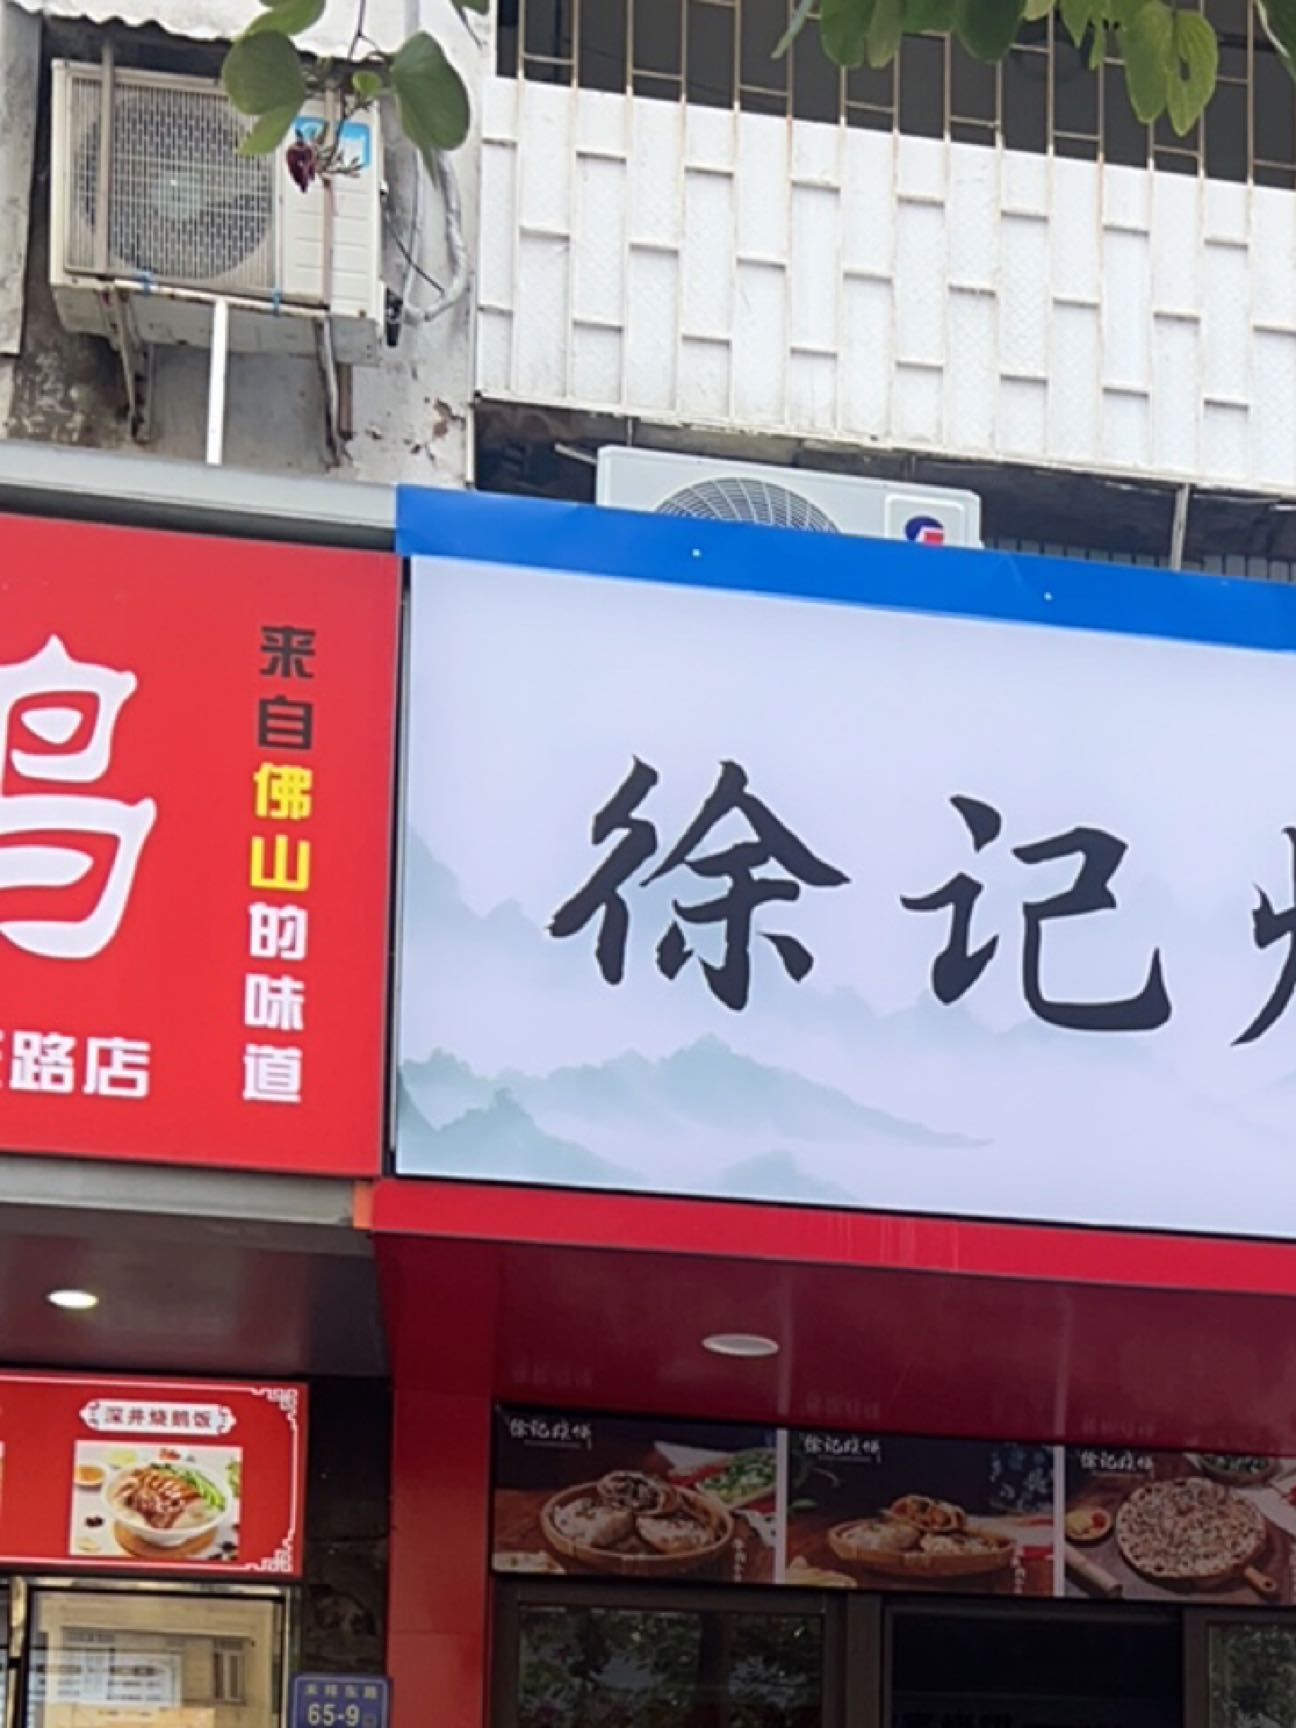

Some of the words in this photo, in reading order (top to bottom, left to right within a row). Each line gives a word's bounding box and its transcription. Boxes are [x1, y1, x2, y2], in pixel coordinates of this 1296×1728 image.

[241, 624, 318, 1104] 来自佛山的味道
[0, 1029, 152, 1099] 路店
[306, 1702, 362, 1728] 65-9
